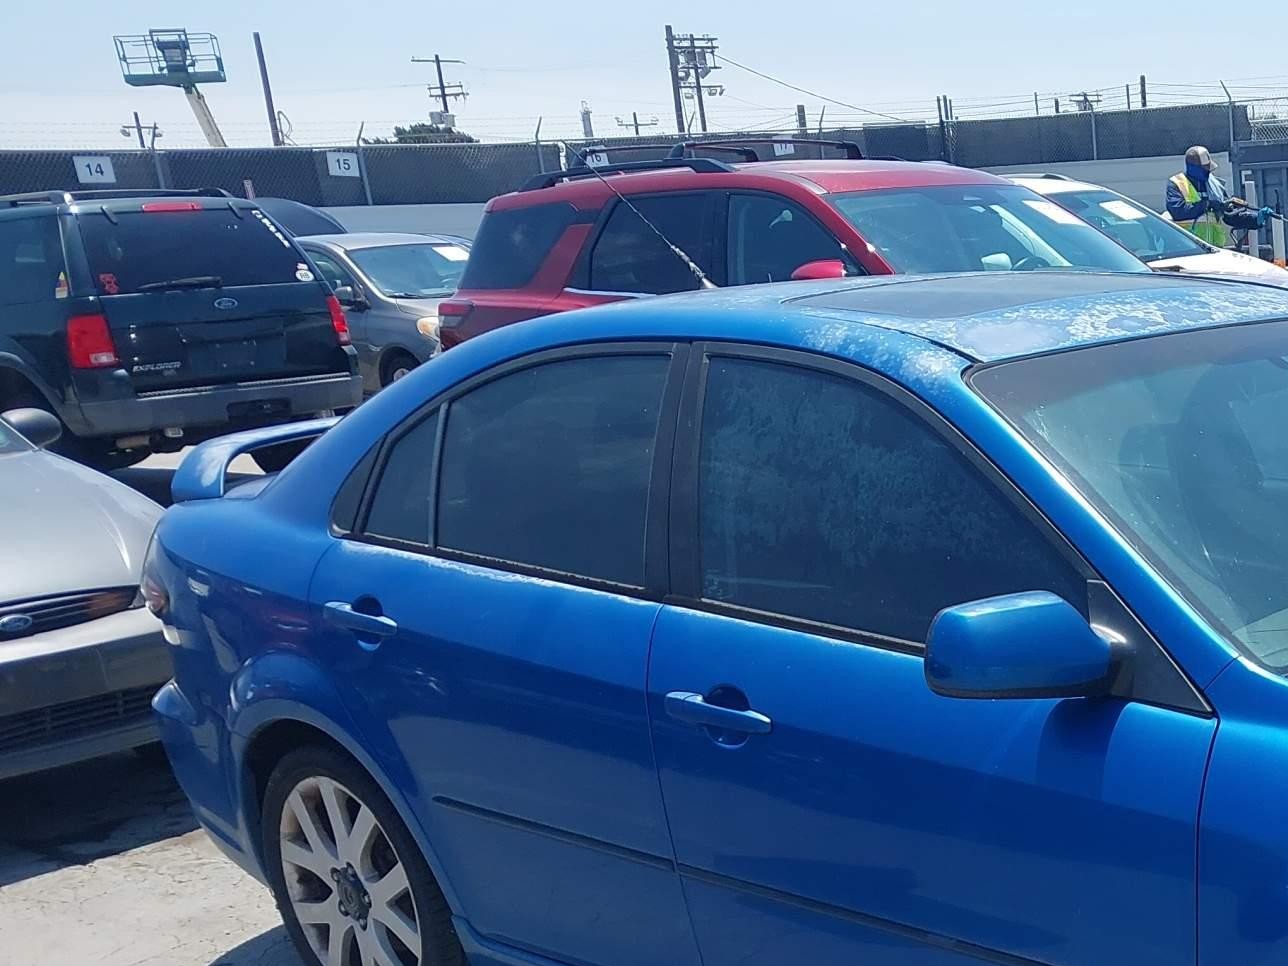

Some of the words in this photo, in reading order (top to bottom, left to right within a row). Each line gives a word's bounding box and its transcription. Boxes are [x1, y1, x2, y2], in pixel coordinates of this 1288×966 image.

[85, 162, 105, 177] 14
[335, 158, 352, 172] 15
[132, 361, 182, 373] EXPLORER
